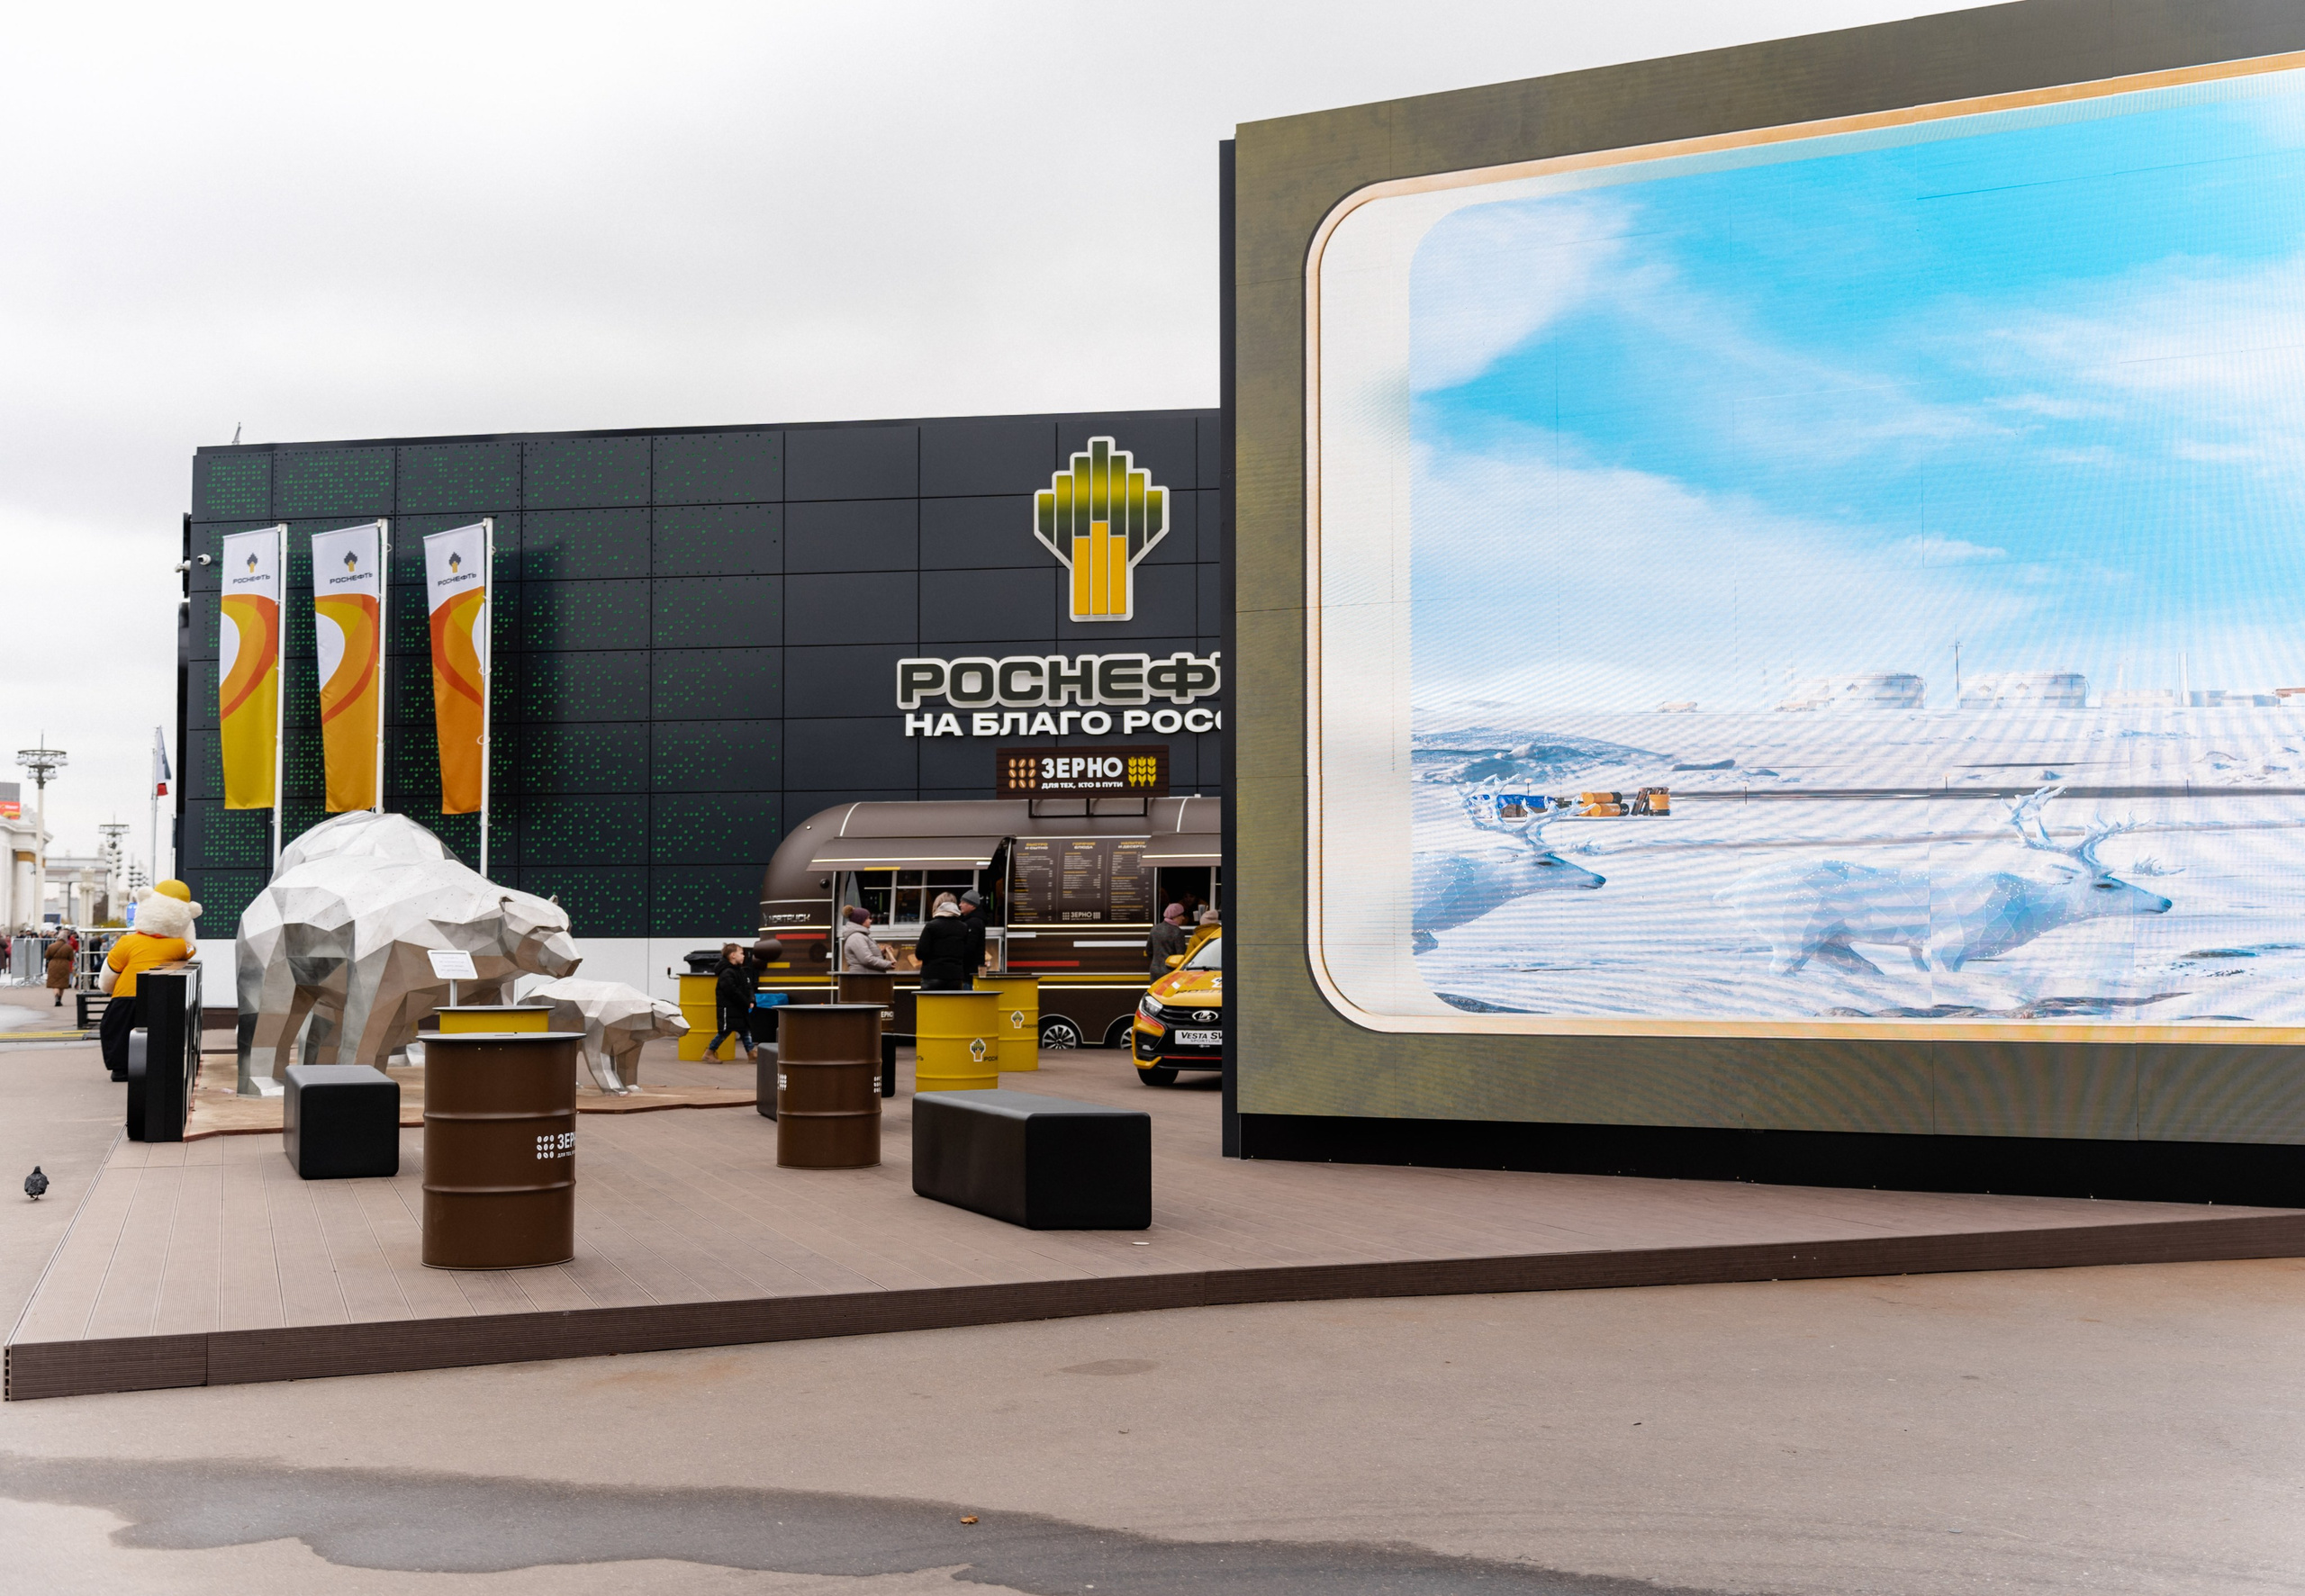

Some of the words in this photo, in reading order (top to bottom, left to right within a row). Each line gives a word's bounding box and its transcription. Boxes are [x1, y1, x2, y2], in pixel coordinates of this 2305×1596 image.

[232, 574, 271, 584] РОСНЕФТЬ
[330, 572, 373, 584] РОСНЕФТЬ
[438, 573, 476, 586] РОСНЕФТЬ
[897, 653, 1221, 709] РОСНЕФ
[905, 712, 963, 737] НА
[972, 710, 1113, 736] БЛАГО
[1123, 708, 1222, 735] РОС
[1041, 757, 1124, 780] ЗЕРНО
[1181, 1032, 1207, 1040] VESTA
